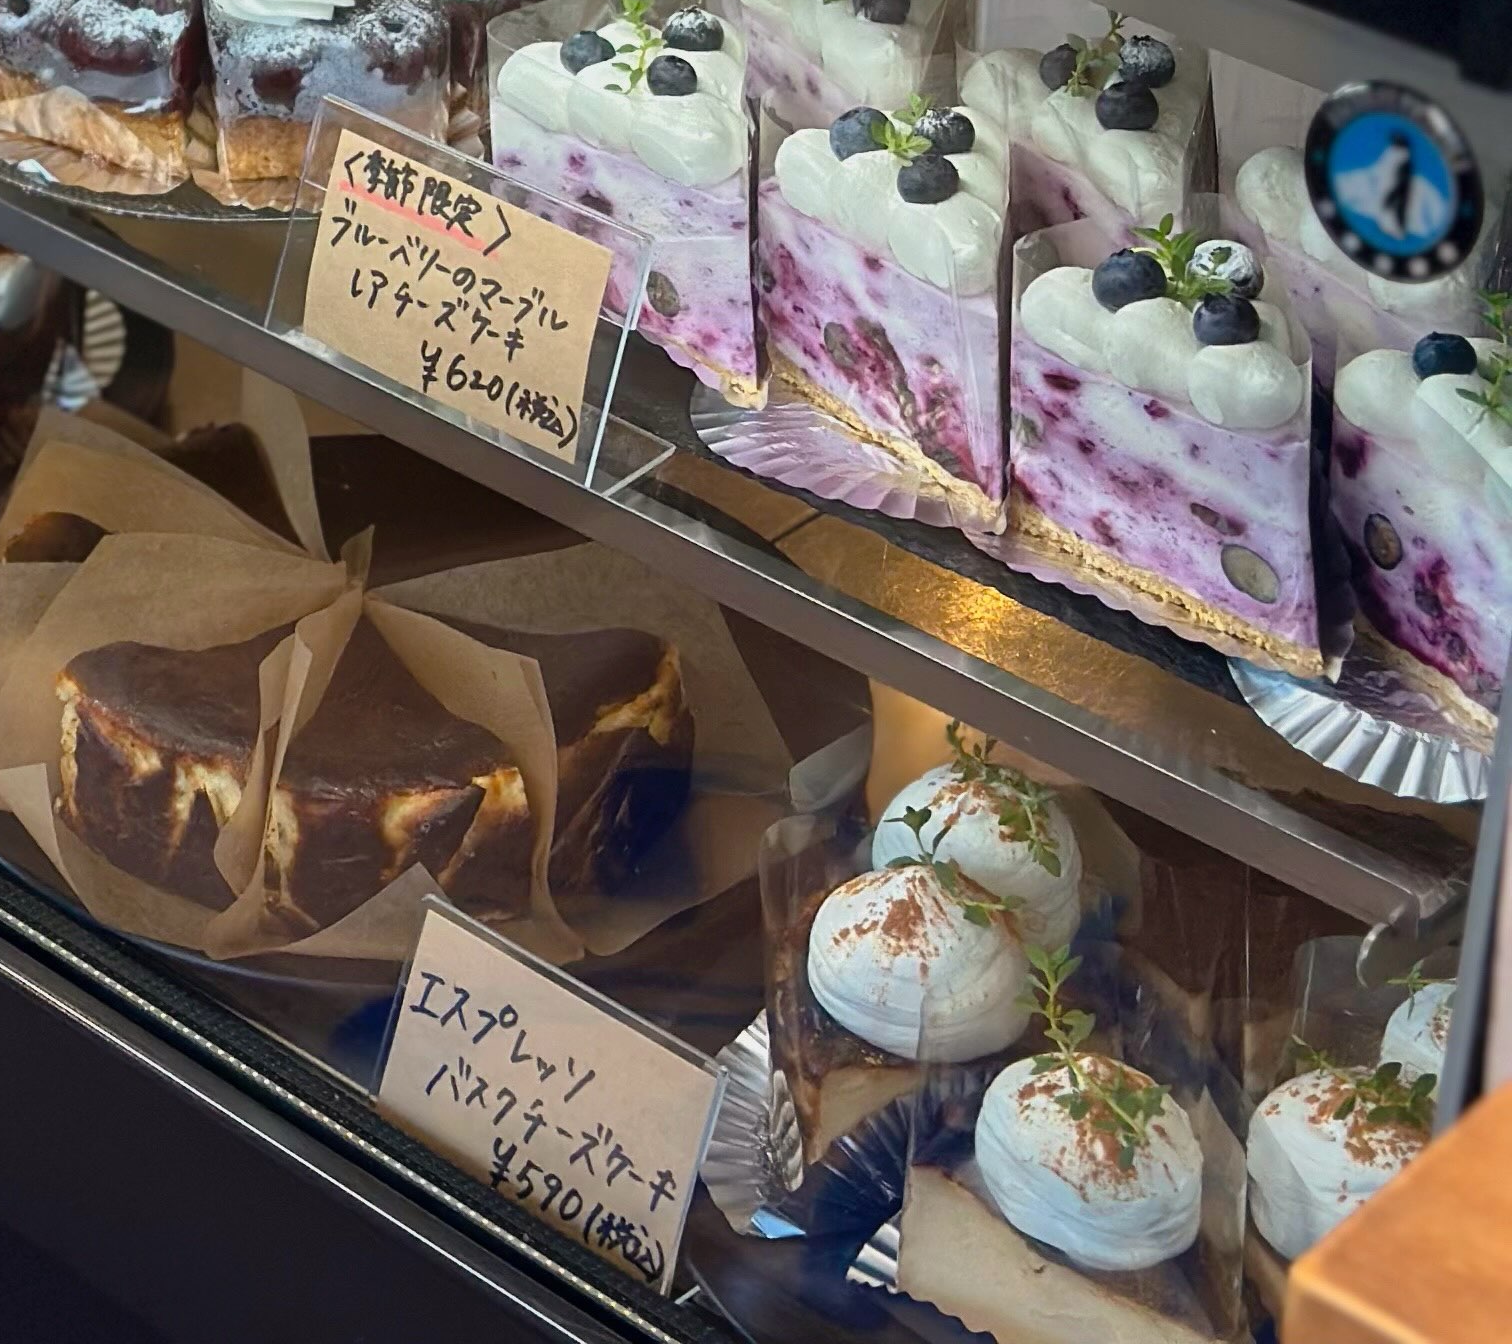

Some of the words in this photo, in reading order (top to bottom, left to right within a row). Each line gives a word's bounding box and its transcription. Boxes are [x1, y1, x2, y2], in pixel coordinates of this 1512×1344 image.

[330, 198, 569, 331] ブルーベリーのマーブル
[350, 268, 526, 363] レアチーズケーキ
[425, 1055, 678, 1212] バスクチーズケーキ
